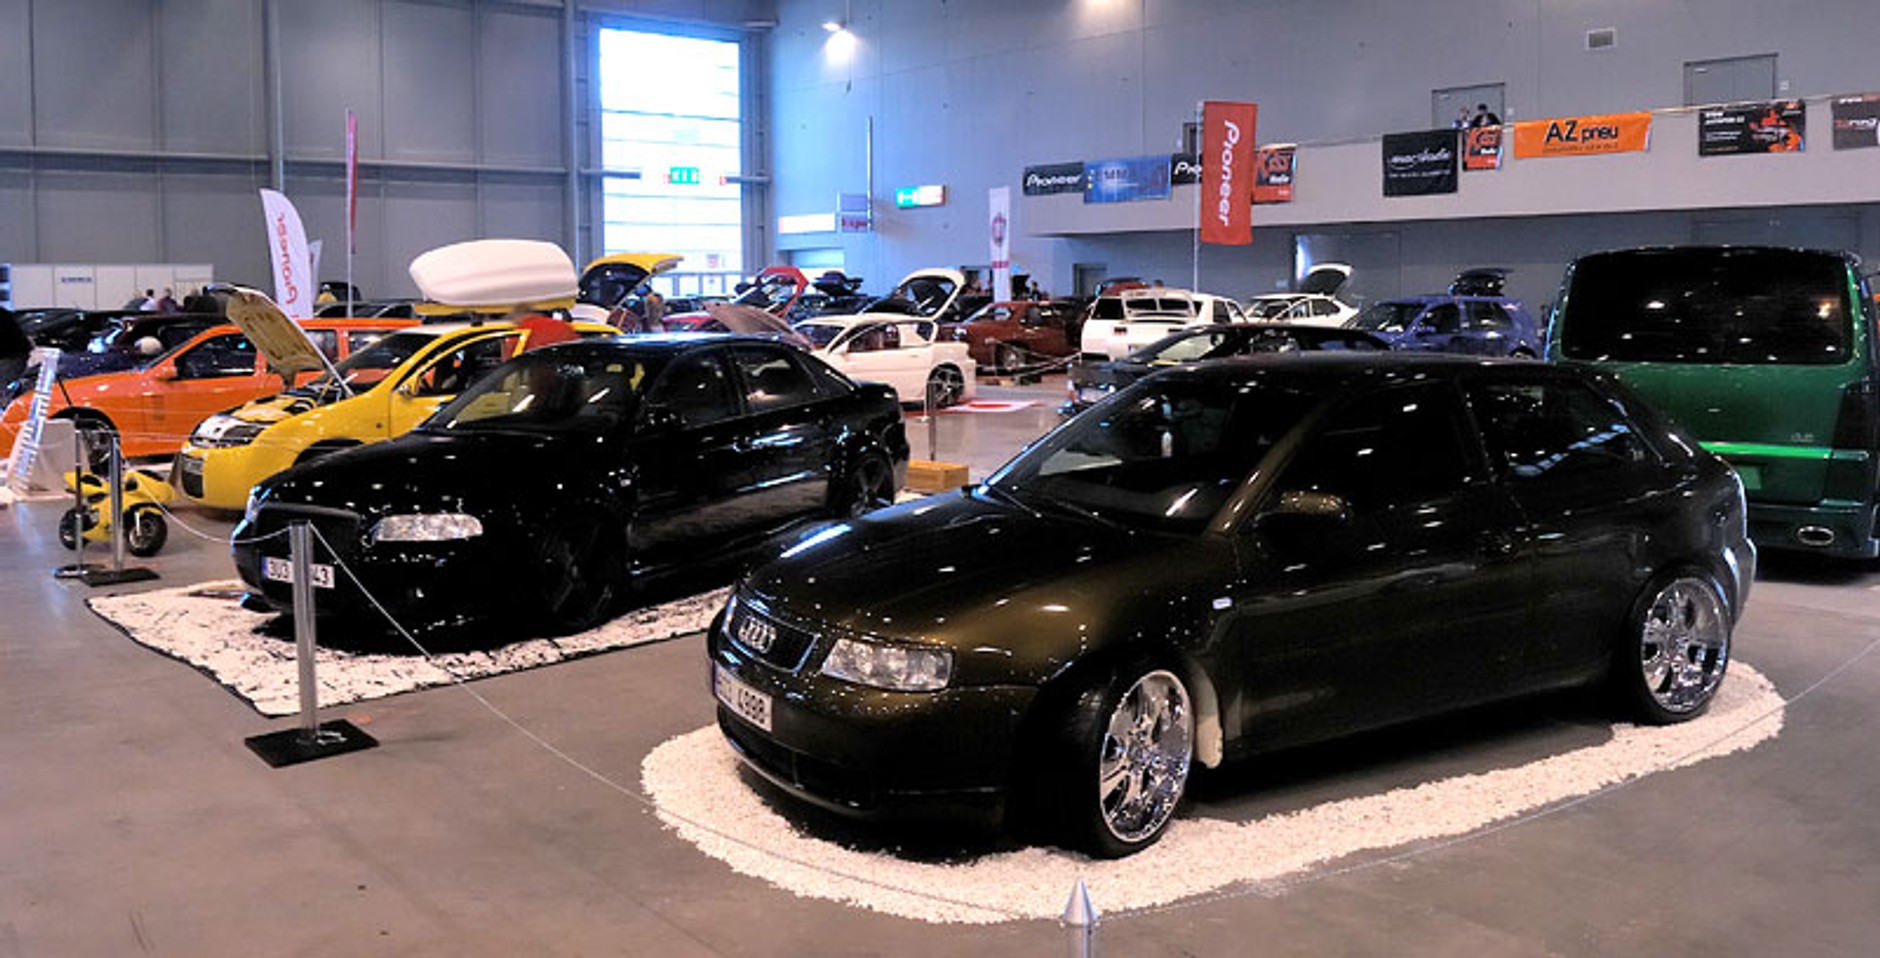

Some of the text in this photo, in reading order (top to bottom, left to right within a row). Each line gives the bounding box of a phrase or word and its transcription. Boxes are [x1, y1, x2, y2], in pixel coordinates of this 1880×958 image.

[1545, 120, 1619, 144] AZ pneu
[1026, 172, 1083, 188] Pioneer
[1218, 119, 1241, 227] Pioneer
